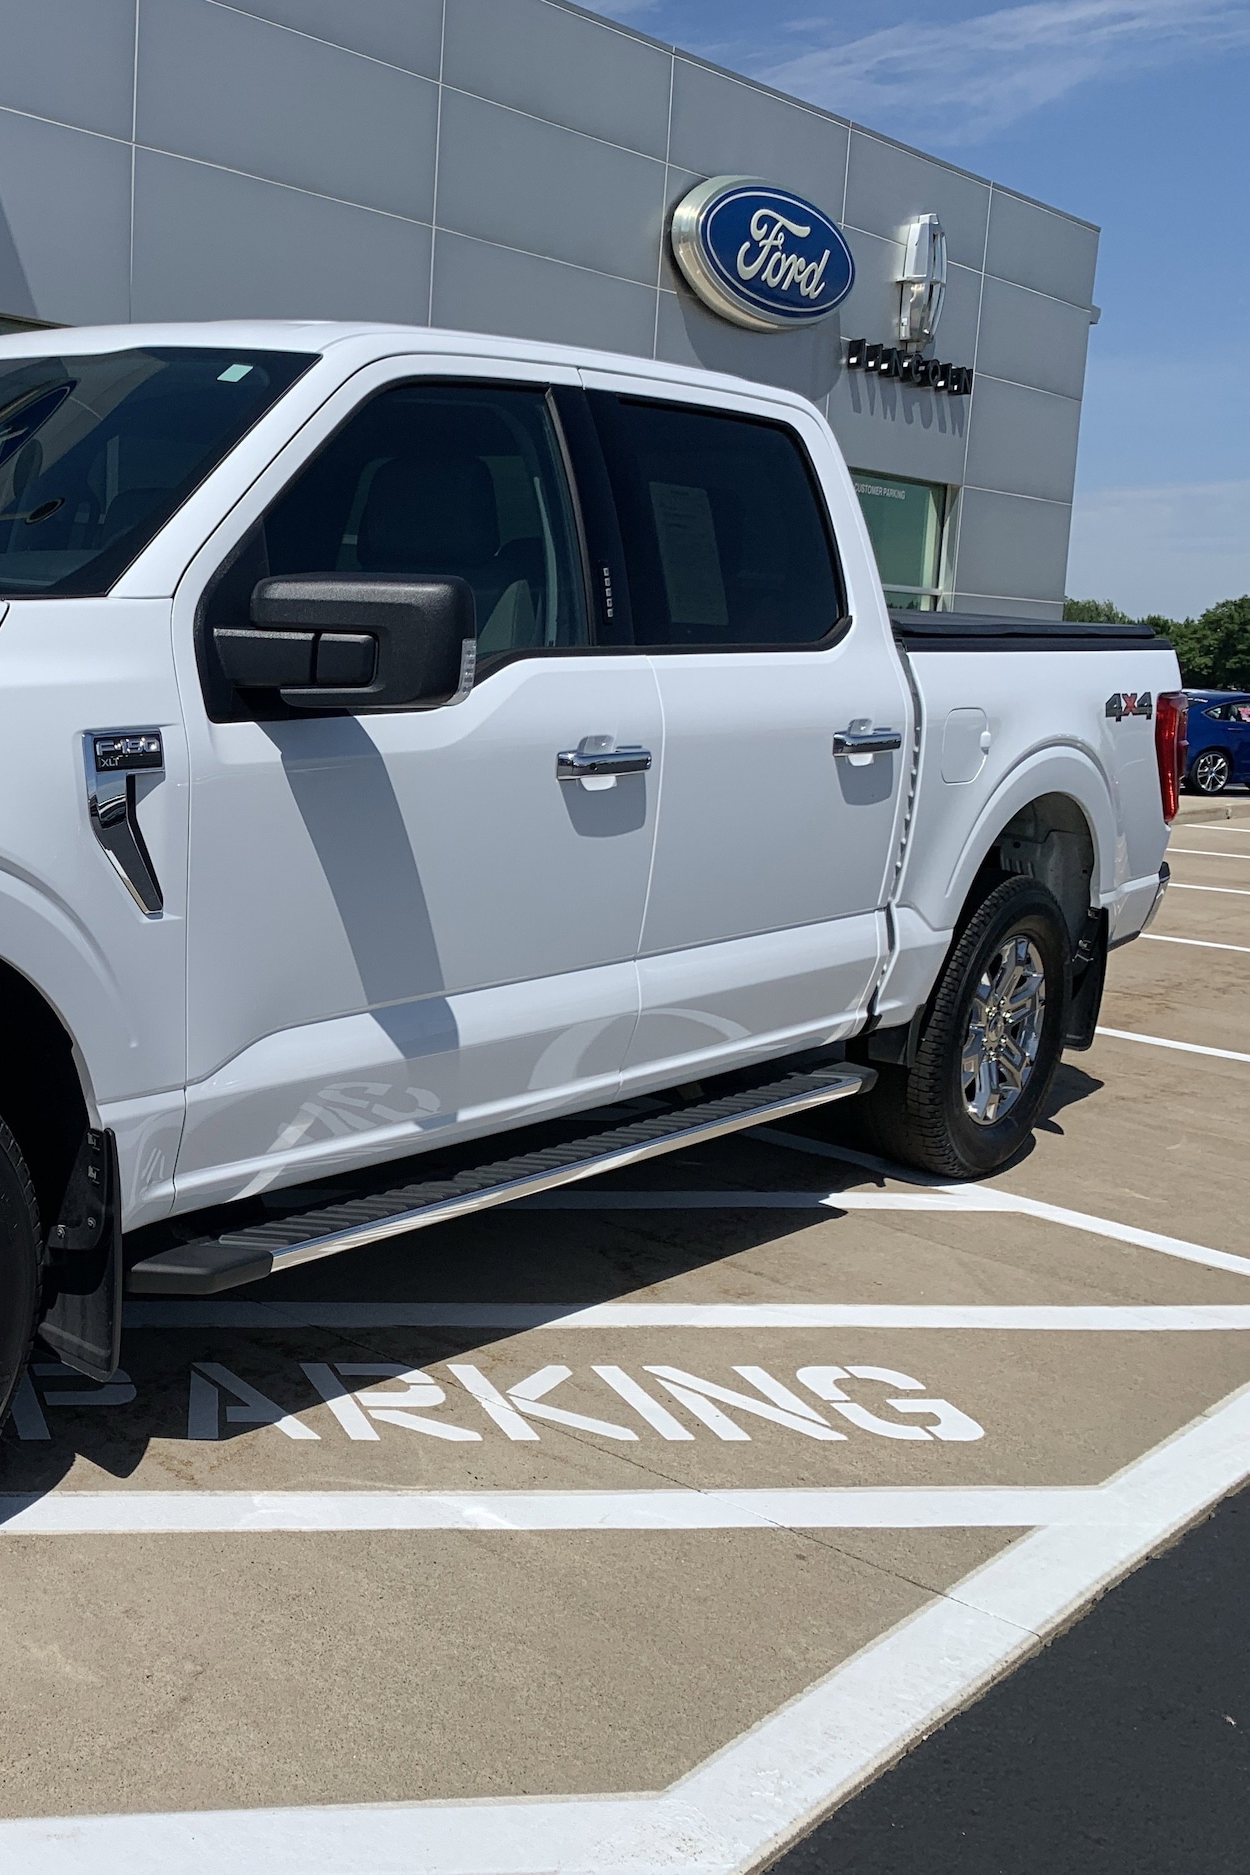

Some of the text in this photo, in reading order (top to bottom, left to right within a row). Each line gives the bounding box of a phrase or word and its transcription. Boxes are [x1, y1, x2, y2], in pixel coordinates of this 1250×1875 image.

[736, 207, 831, 300] Ford
[882, 487, 906, 500] PARKING
[95, 738, 161, 757] F-150
[101, 757, 120, 768] XLT
[11, 1361, 986, 1442] PARKING
